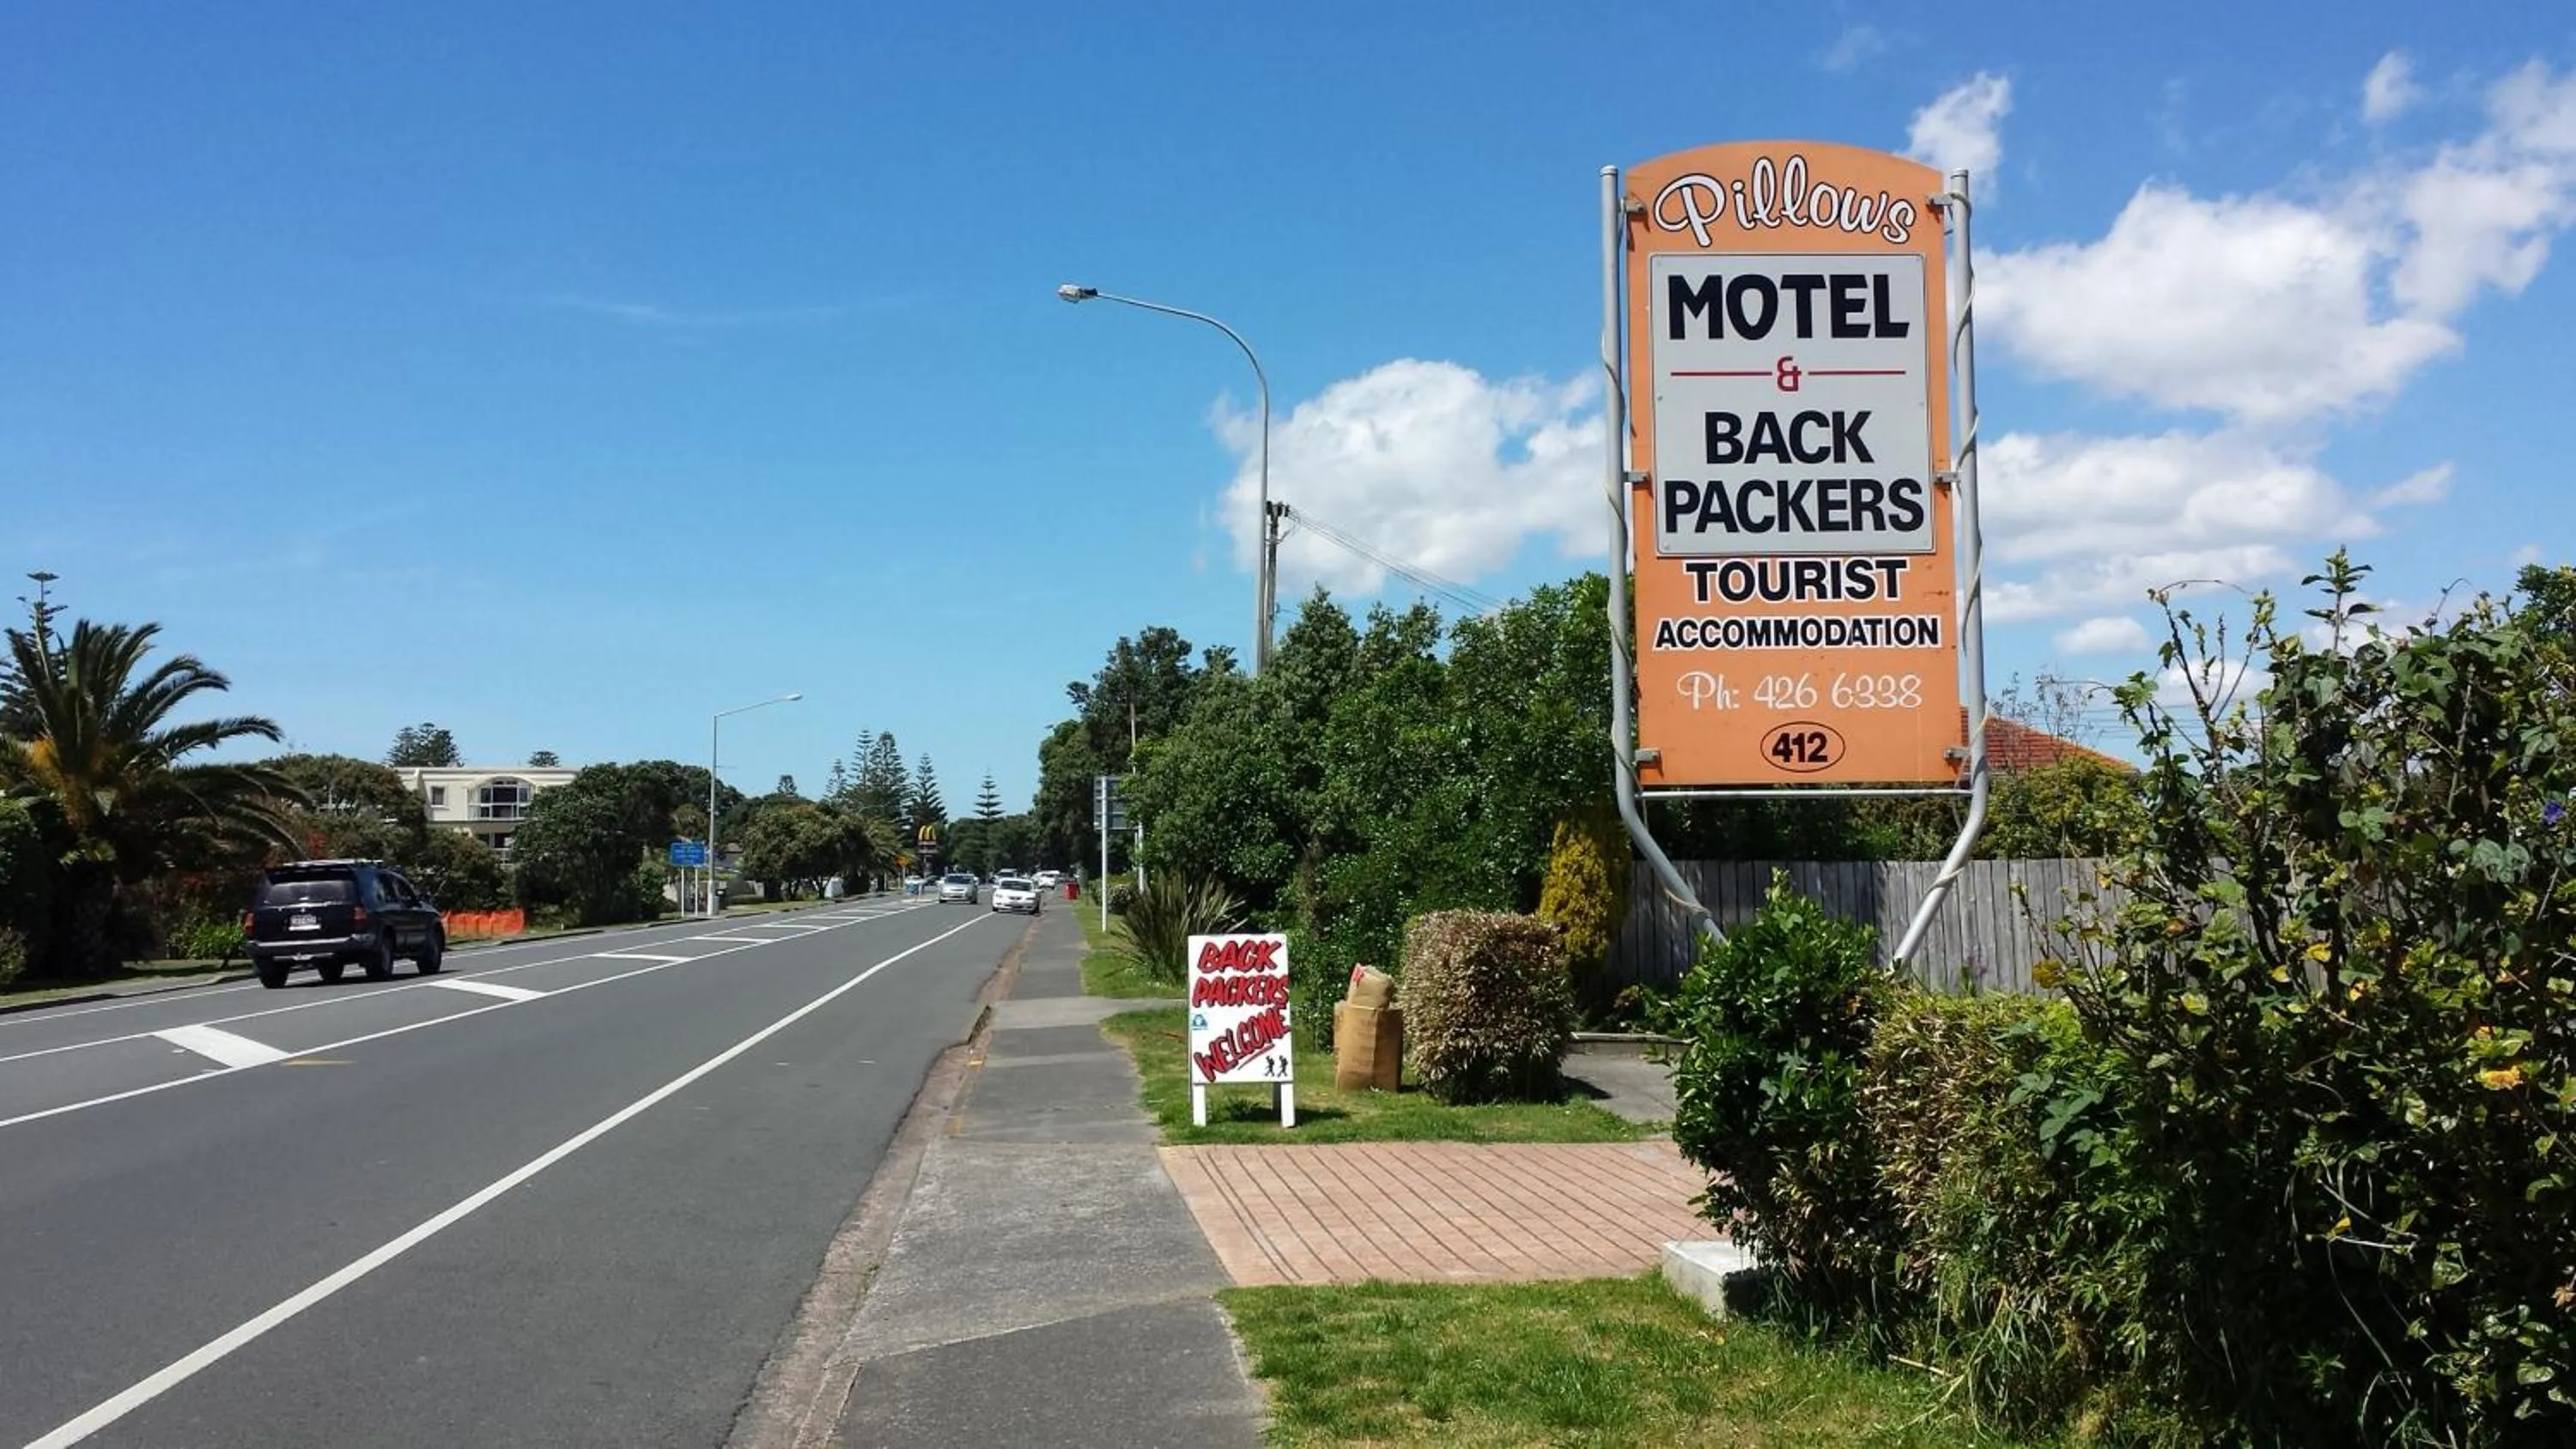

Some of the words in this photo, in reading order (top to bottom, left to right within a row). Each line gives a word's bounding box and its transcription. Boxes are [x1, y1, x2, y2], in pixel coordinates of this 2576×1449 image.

[1654, 155, 1917, 247] Pillows
[1668, 274, 1910, 340] MOTEL
[1777, 356, 1801, 392] &
[1704, 410, 1874, 464] BACK
[1664, 478, 1924, 533] PACKERS
[1684, 557, 1910, 603] TOURIST
[1653, 615, 1942, 652] ACCOMMODATION
[1676, 670, 1740, 711] Ph:
[1753, 673, 1818, 710] 426
[1832, 672, 1923, 709] 6338
[1771, 731, 1828, 763] 412
[1197, 939, 1282, 973] BACK
[1192, 974, 1291, 1009] PACKERS
[1194, 1006, 1291, 1082] WELCOME
